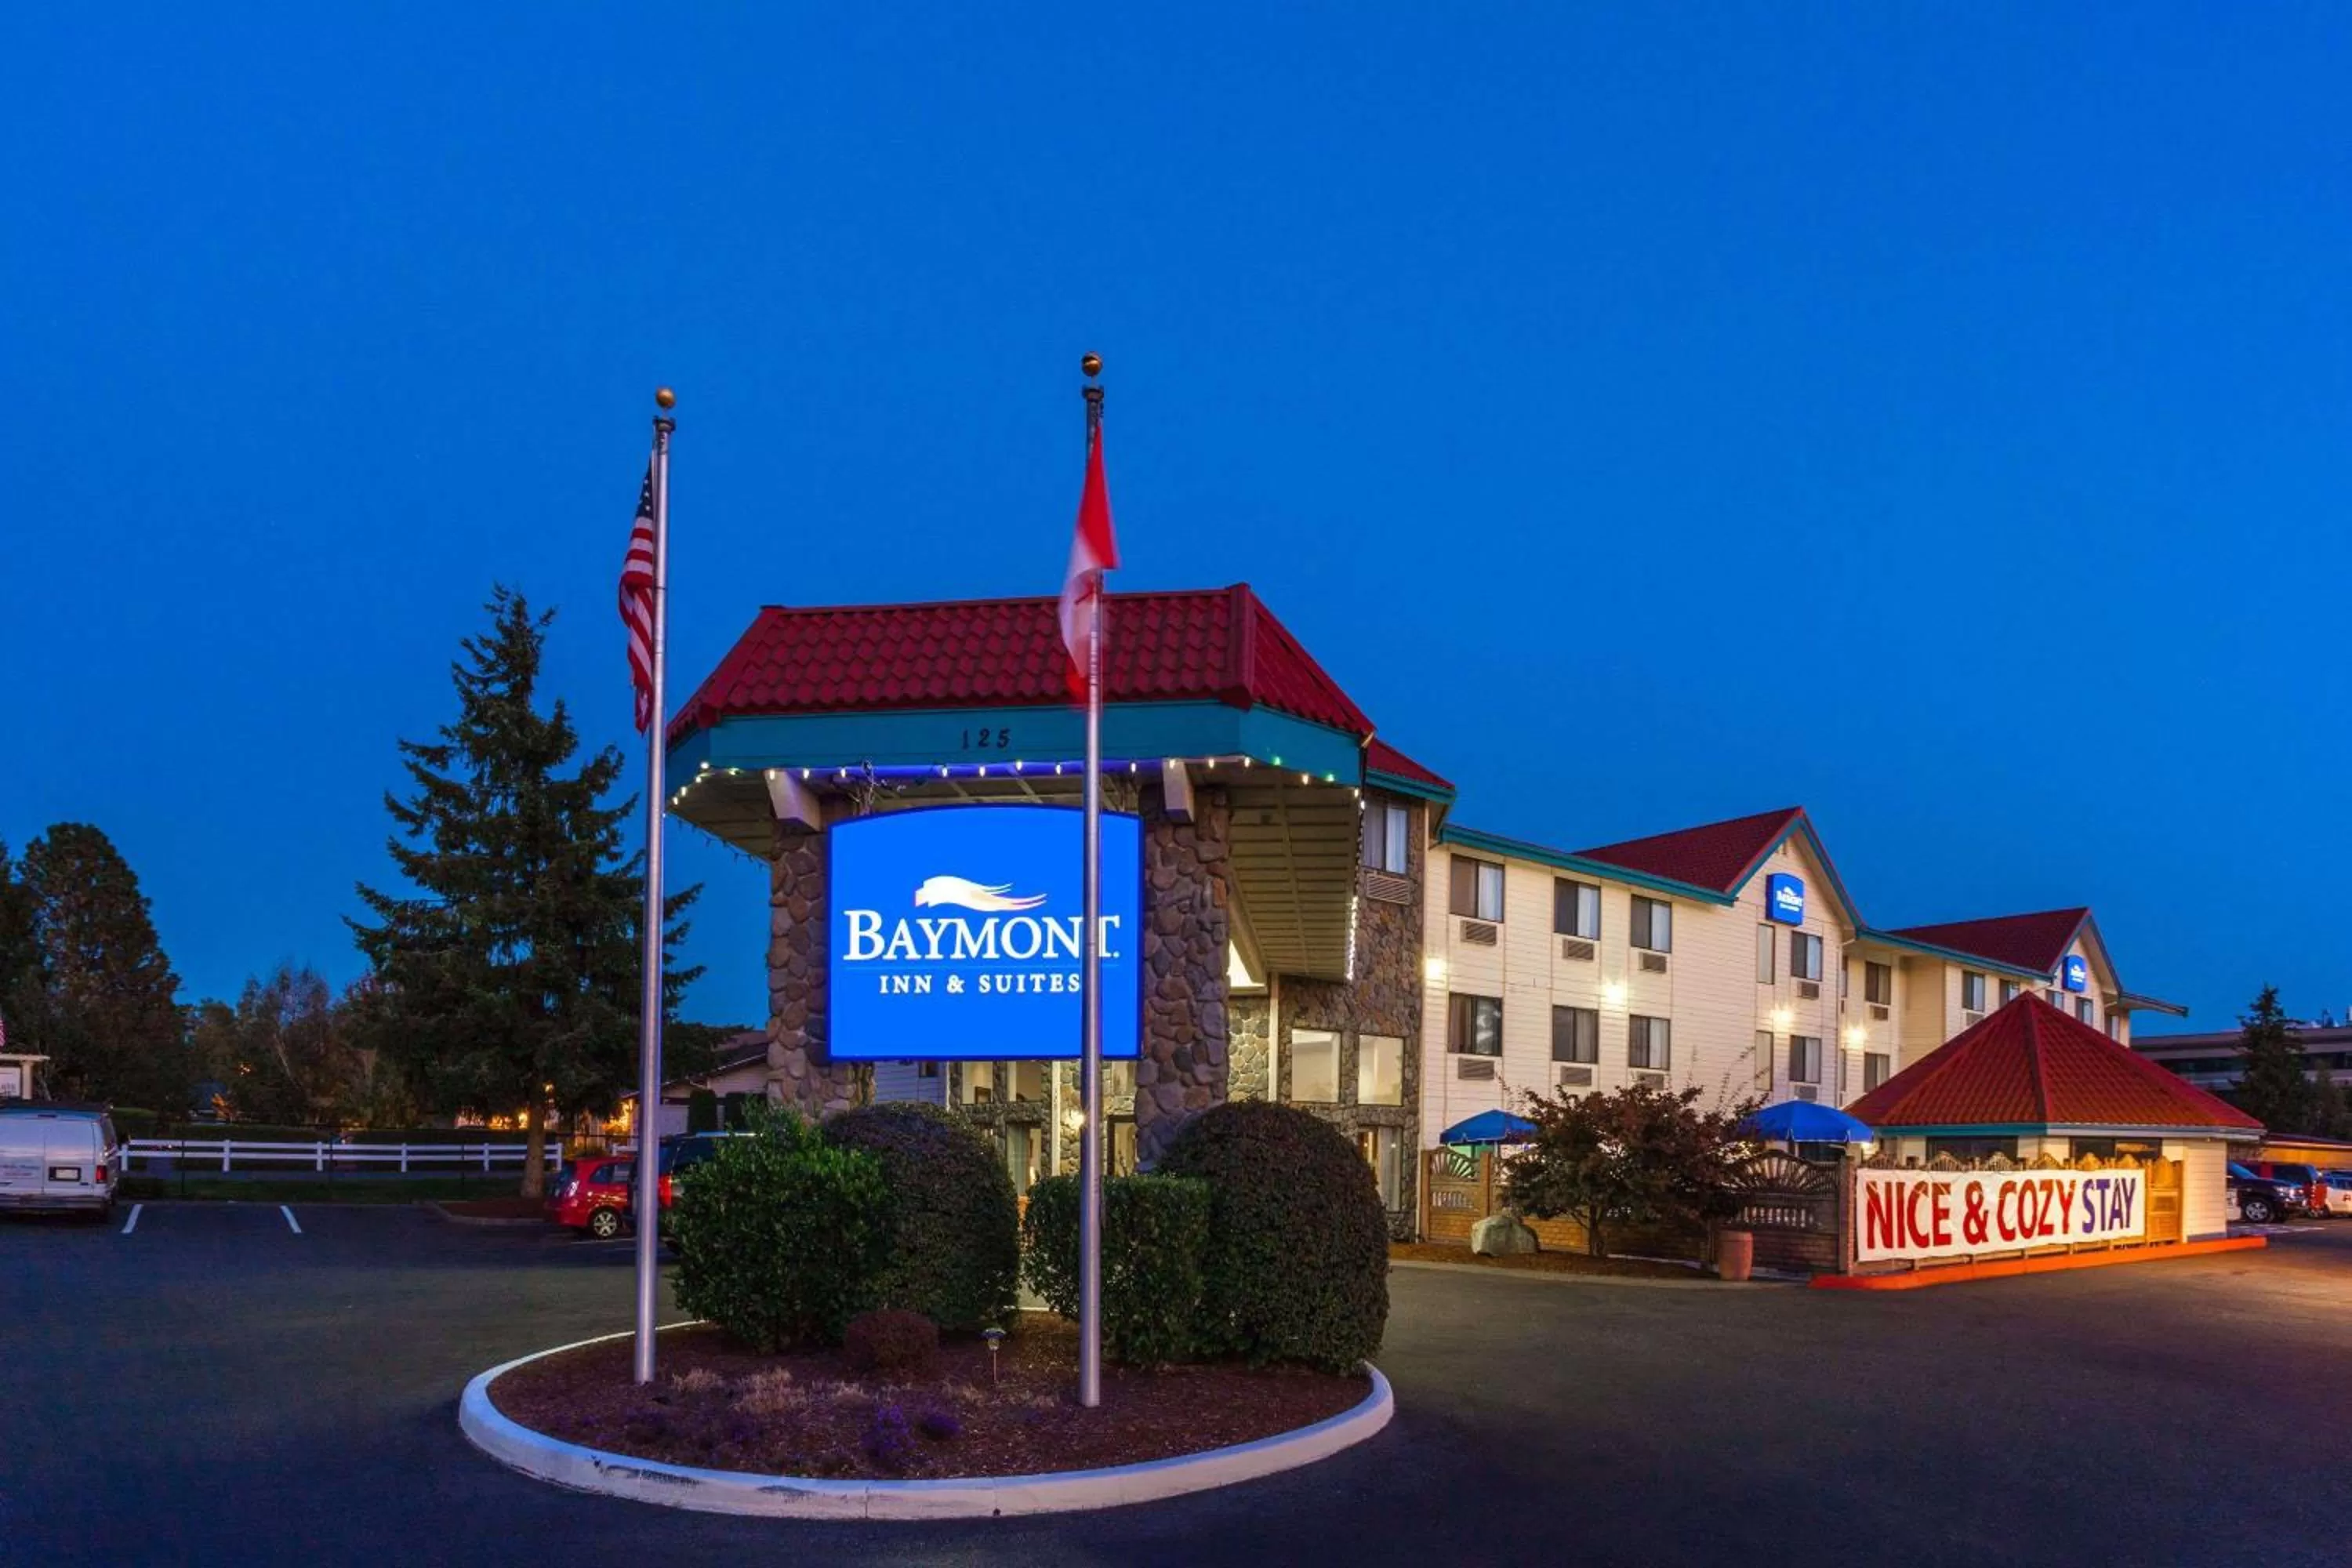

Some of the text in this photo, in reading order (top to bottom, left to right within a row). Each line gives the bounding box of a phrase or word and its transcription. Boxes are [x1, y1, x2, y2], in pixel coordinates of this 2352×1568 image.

[961, 728, 1011, 750] 125
[879, 973, 1080, 994] INN & SUITES
[1865, 1178, 2136, 1250] NICE & COZY STAY
